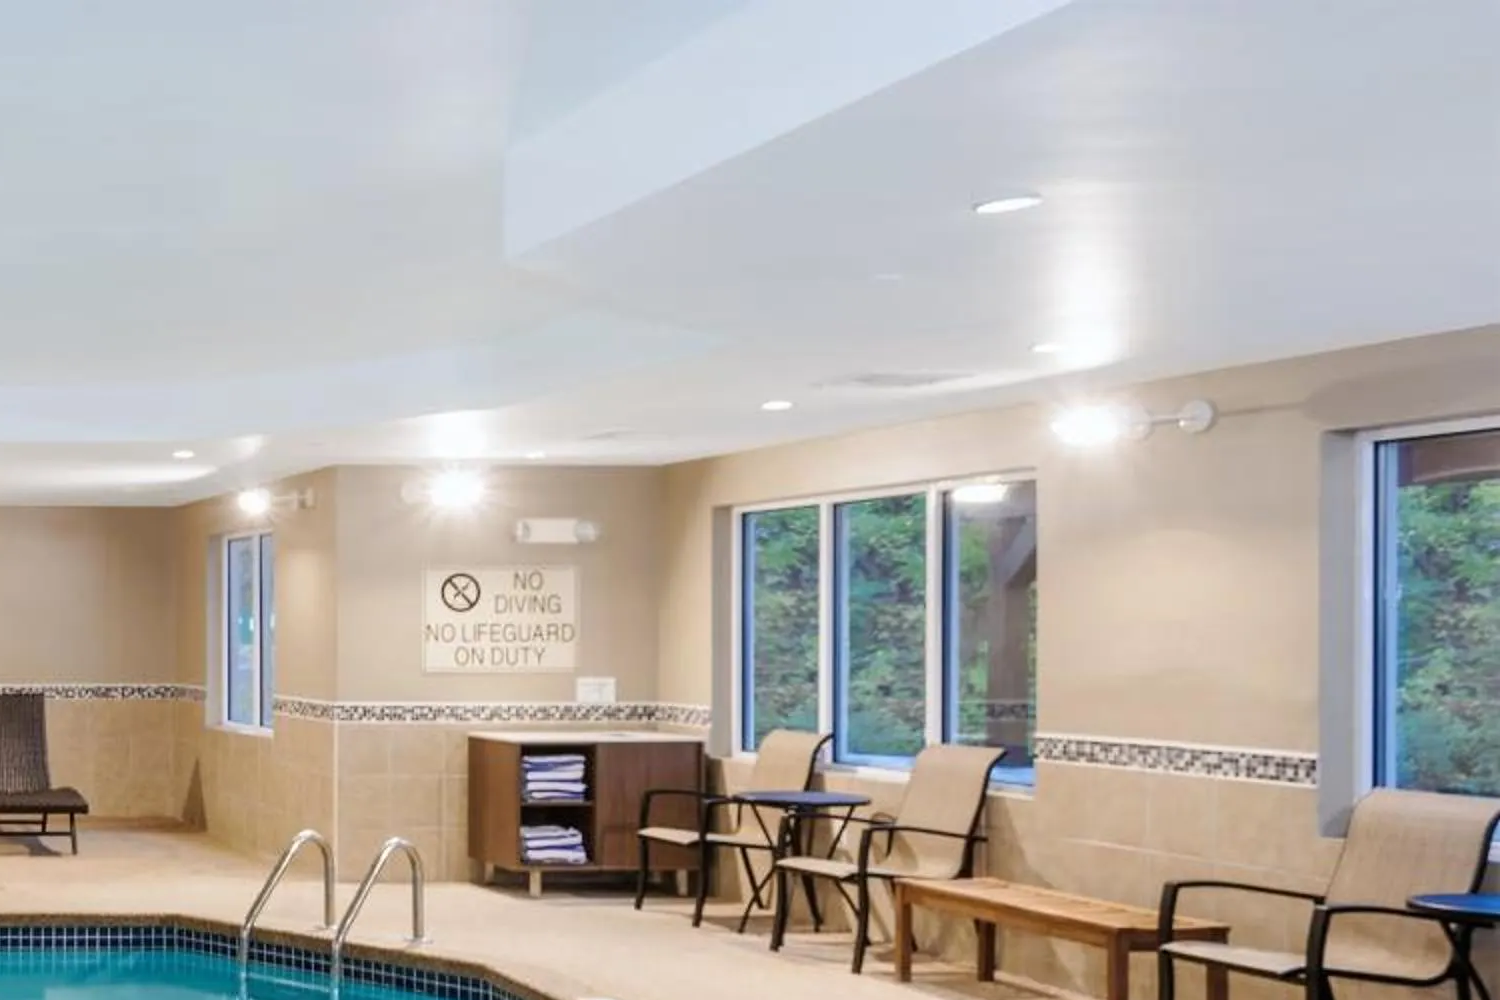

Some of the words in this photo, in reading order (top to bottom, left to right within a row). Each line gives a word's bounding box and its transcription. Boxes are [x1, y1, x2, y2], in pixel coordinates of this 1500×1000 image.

[513, 571, 544, 590] NO
[494, 594, 562, 614] DIVING
[426, 623, 456, 643] NO
[462, 623, 575, 643] LIFEGUARD
[454, 646, 485, 666] ON
[491, 647, 545, 666] DUTY
